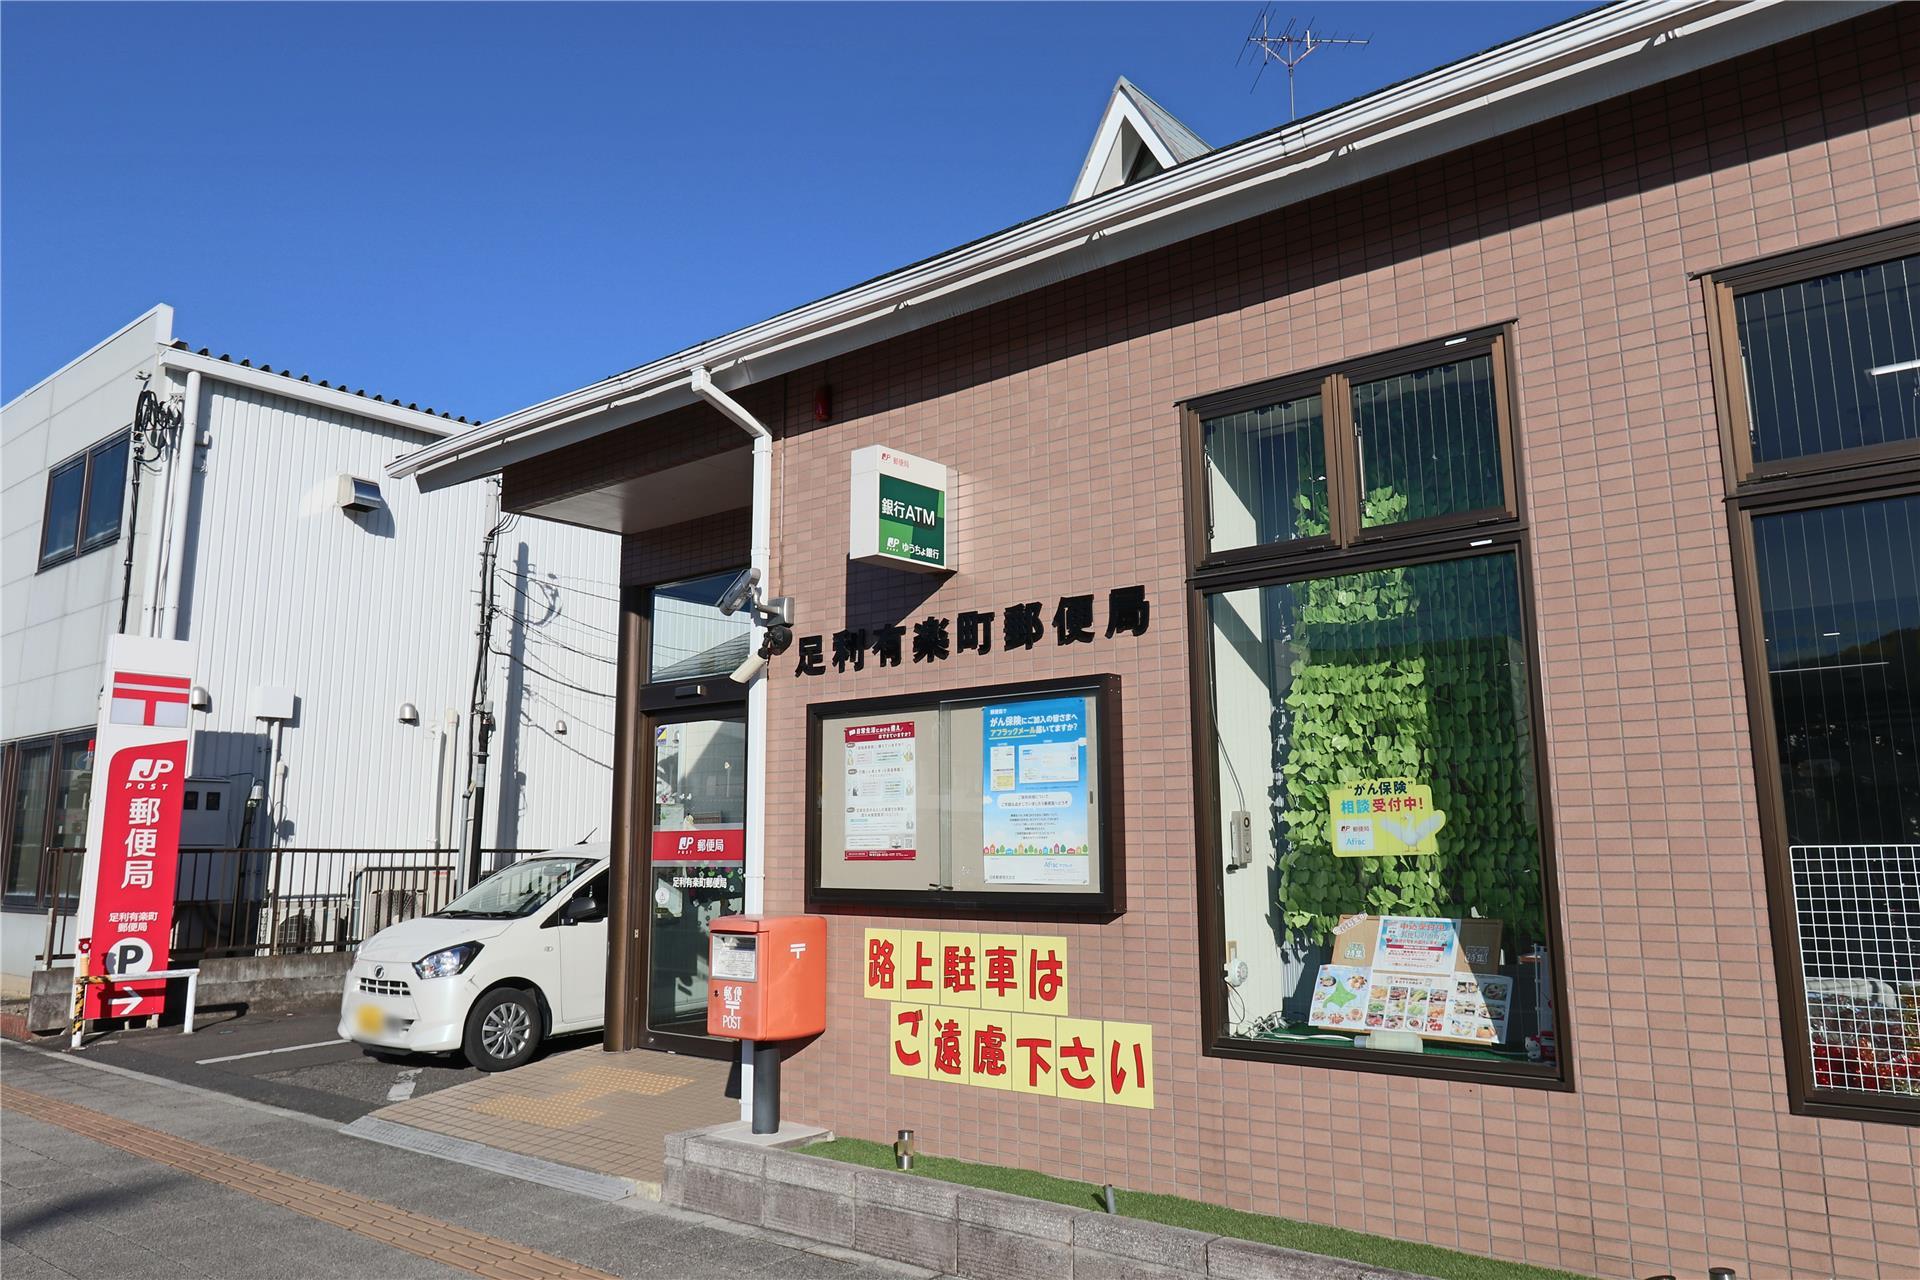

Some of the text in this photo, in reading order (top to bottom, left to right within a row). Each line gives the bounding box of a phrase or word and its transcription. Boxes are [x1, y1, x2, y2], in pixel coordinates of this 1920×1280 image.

[881, 497, 935, 526] 銀行ATM
[902, 542, 940, 560] ゆうちょ銀行
[795, 584, 1151, 678] 足利有楽町郵便局
[990, 713, 1078, 728] がん保険にご加入の皆さまへ
[128, 758, 174, 781] JP
[1341, 796, 1423, 815] 相談受付中!
[121, 797, 161, 889] 郵便局
[697, 839, 724, 853] 郵便局
[673, 877, 727, 889] 足利有楽町郵便局
[109, 911, 158, 923] 足利有楽町
[117, 922, 148, 933] 郵便局
[117, 945, 144, 974] P
[868, 938, 1063, 1001] 路上駐車は
[722, 1015, 741, 1029] POST
[895, 1009, 1145, 1095] ご遠慮下さい
